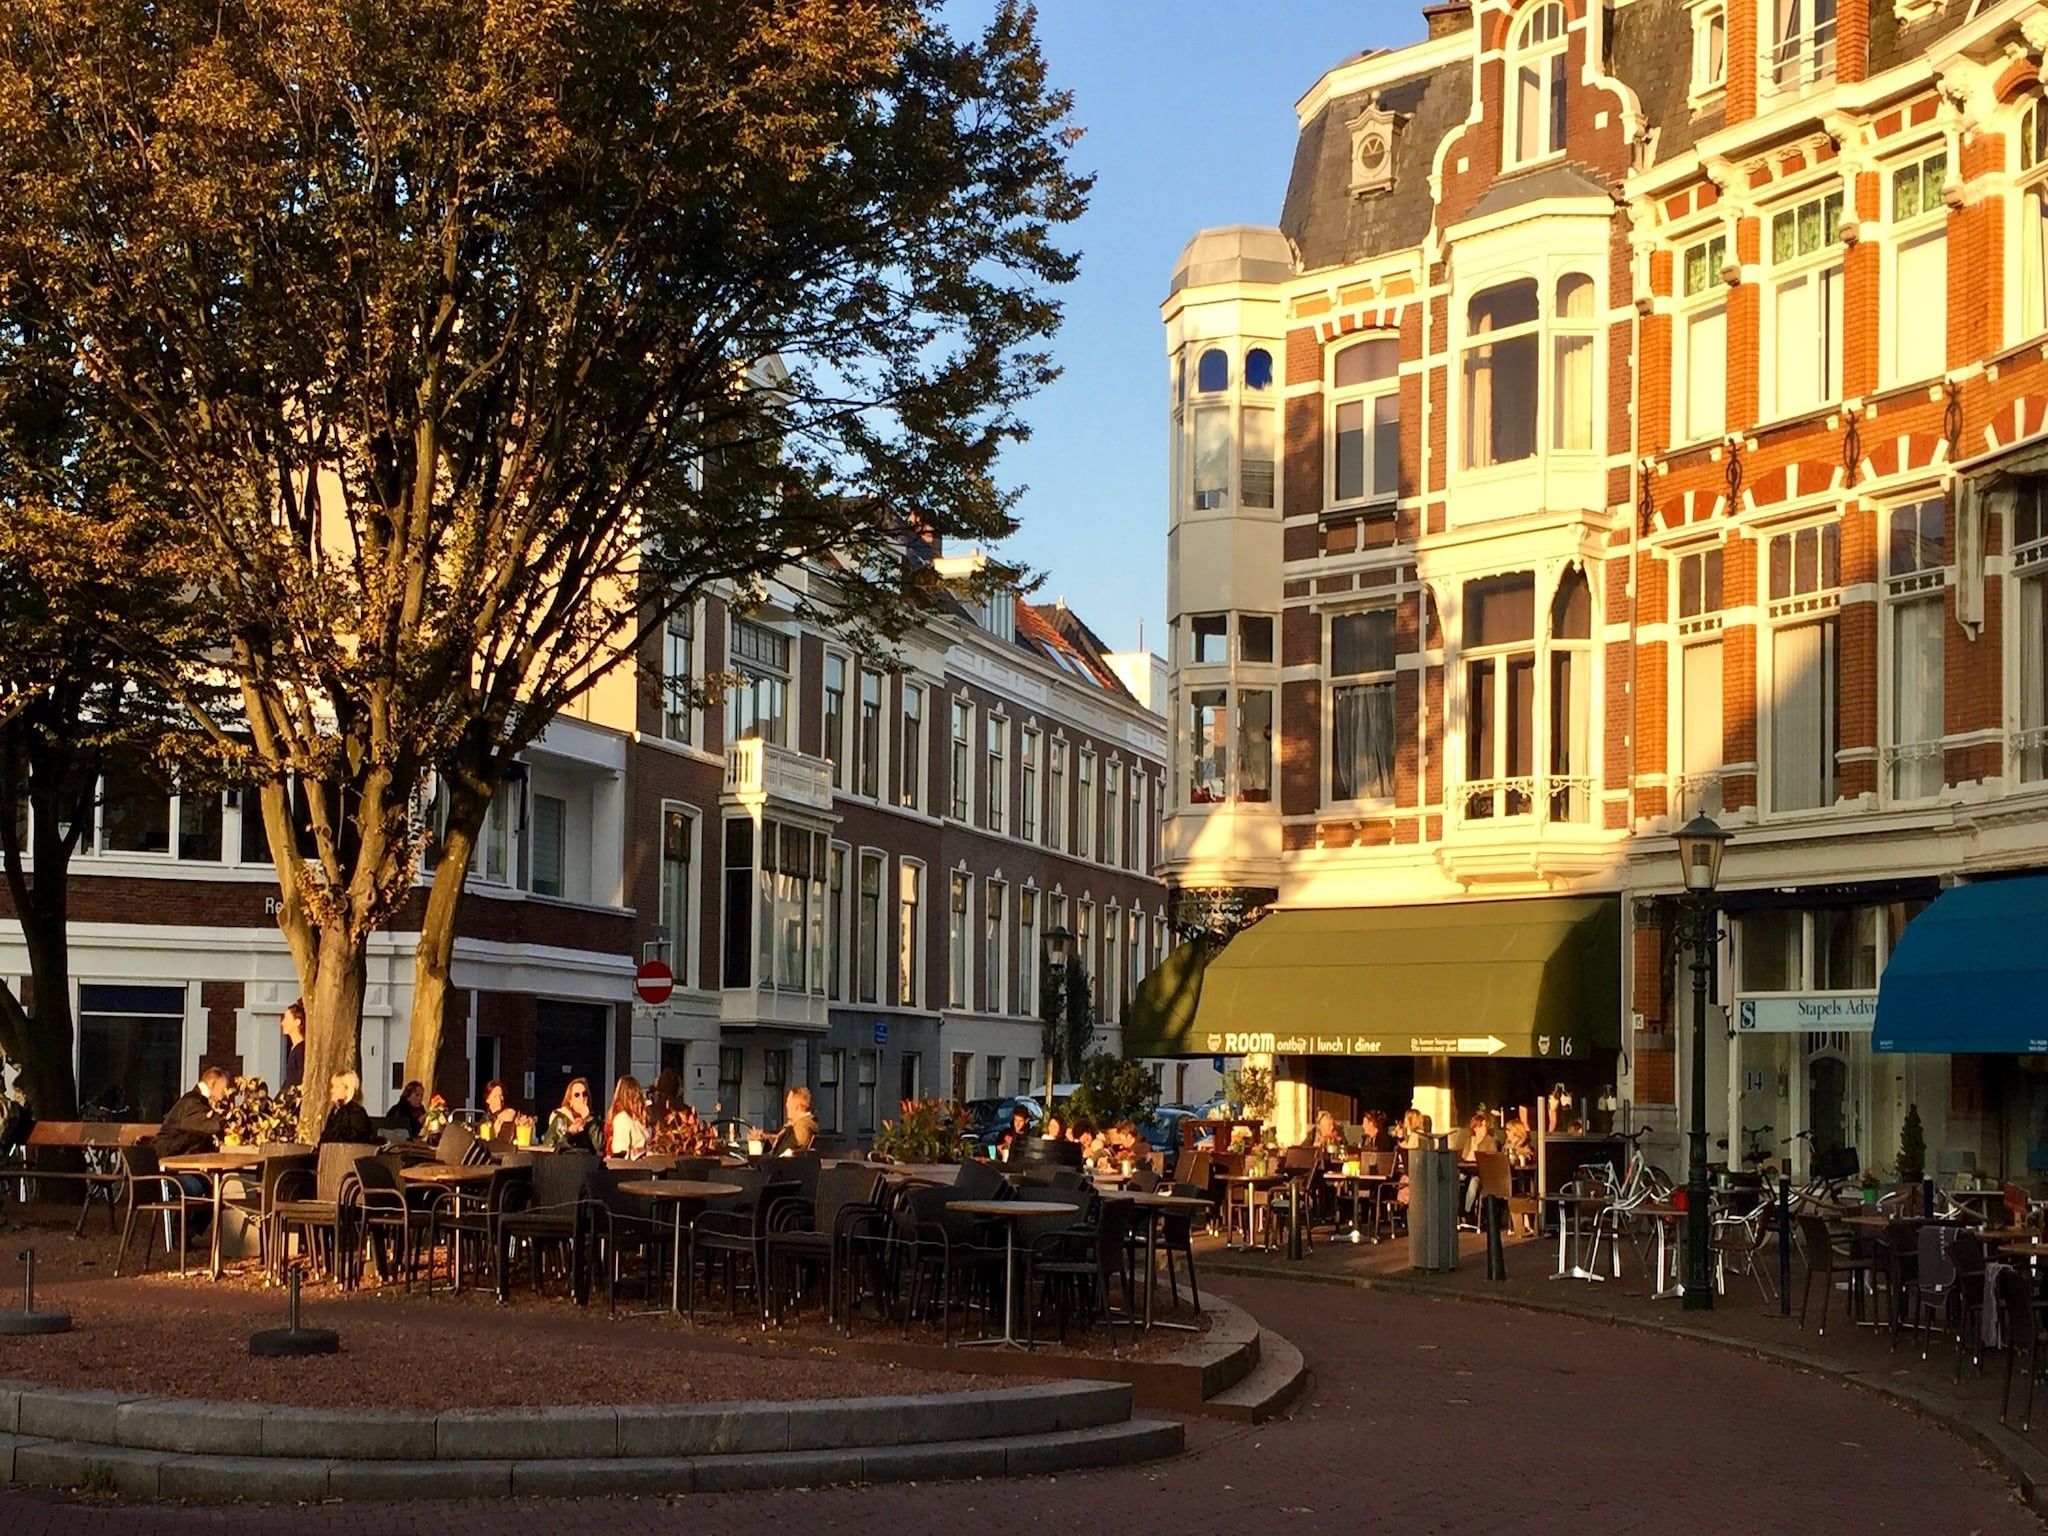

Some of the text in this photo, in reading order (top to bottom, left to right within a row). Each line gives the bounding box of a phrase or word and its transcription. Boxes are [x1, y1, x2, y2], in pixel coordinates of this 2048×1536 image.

[1741, 1001, 1755, 1028] S
[1798, 999, 1874, 1020] Stapels Advi
[1224, 1032, 1381, 1054] ROOM ontbijt lunch diner
[1560, 1036, 1573, 1056] 16
[1747, 1071, 1763, 1090] 14
